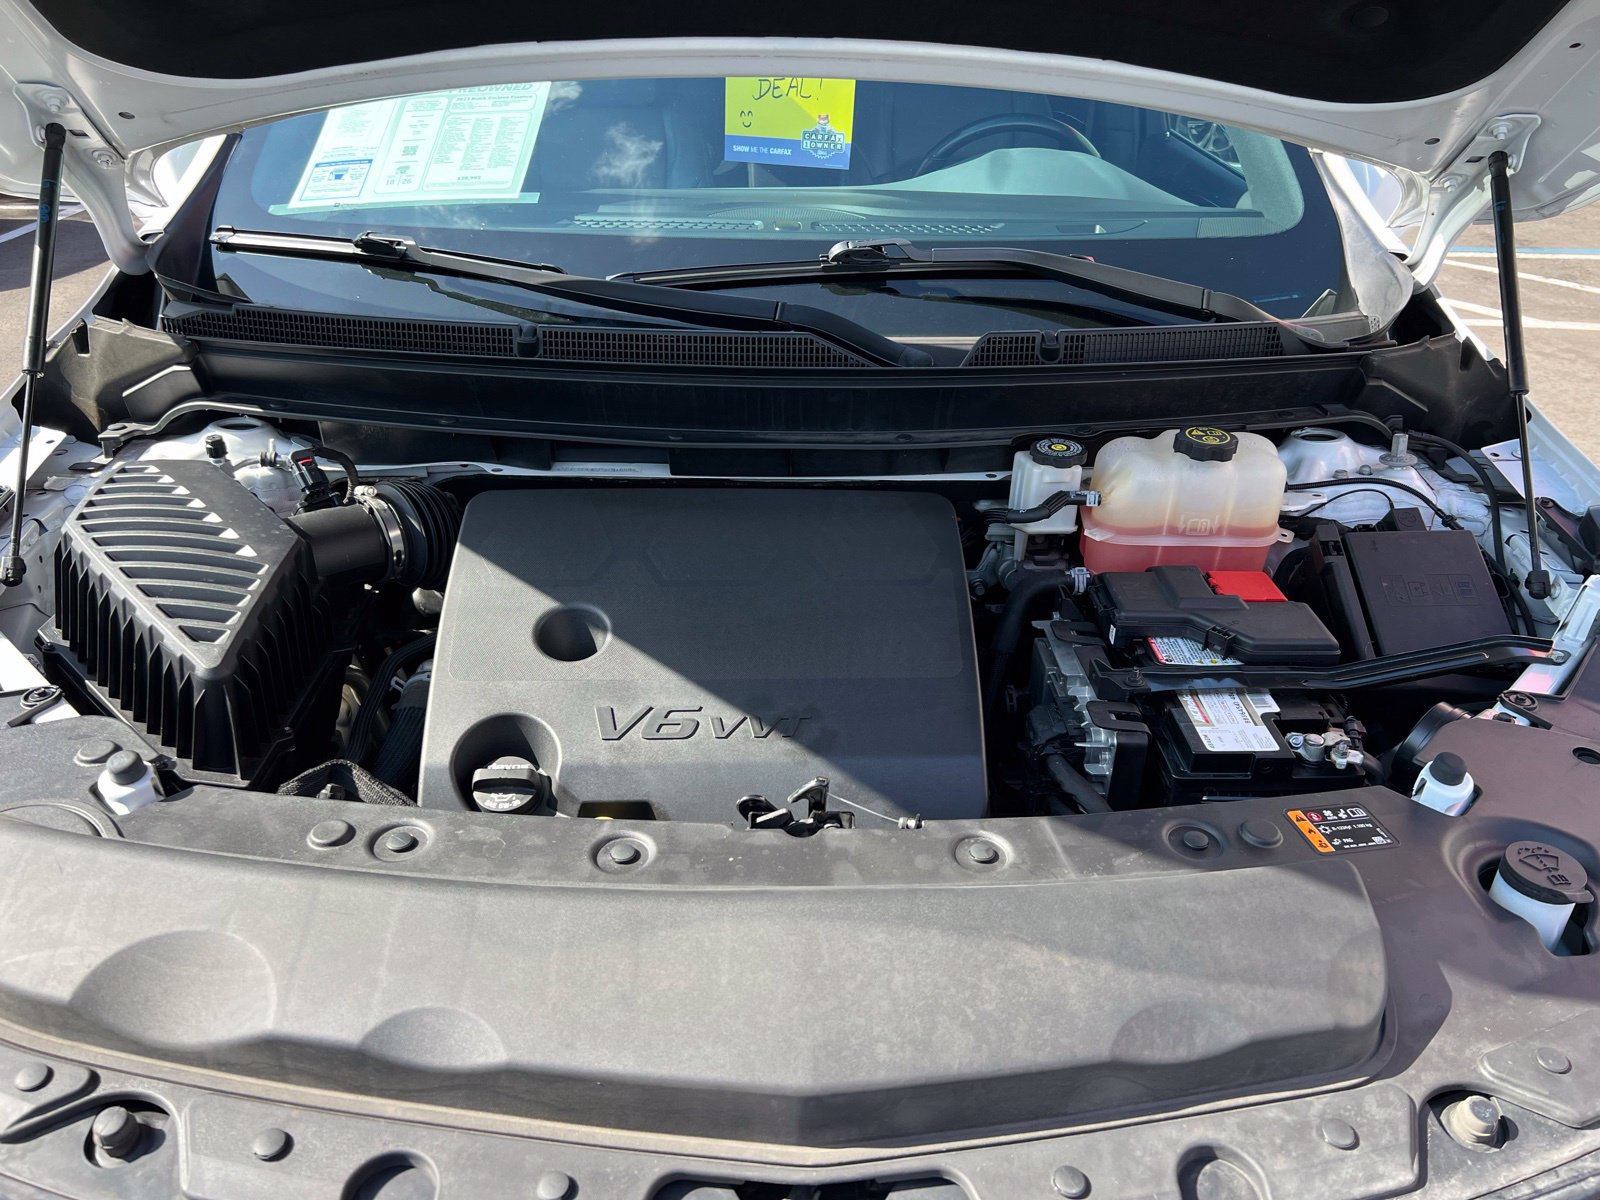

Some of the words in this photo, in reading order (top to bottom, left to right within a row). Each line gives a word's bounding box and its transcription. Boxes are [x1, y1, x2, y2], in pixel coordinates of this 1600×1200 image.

[448, 83, 534, 93] REOWNED
[804, 133, 843, 143] CARFAX
[811, 141, 842, 150] OWNER
[770, 147, 792, 155] CARFAX
[595, 706, 703, 741] V6
[709, 716, 812, 739] VVT
